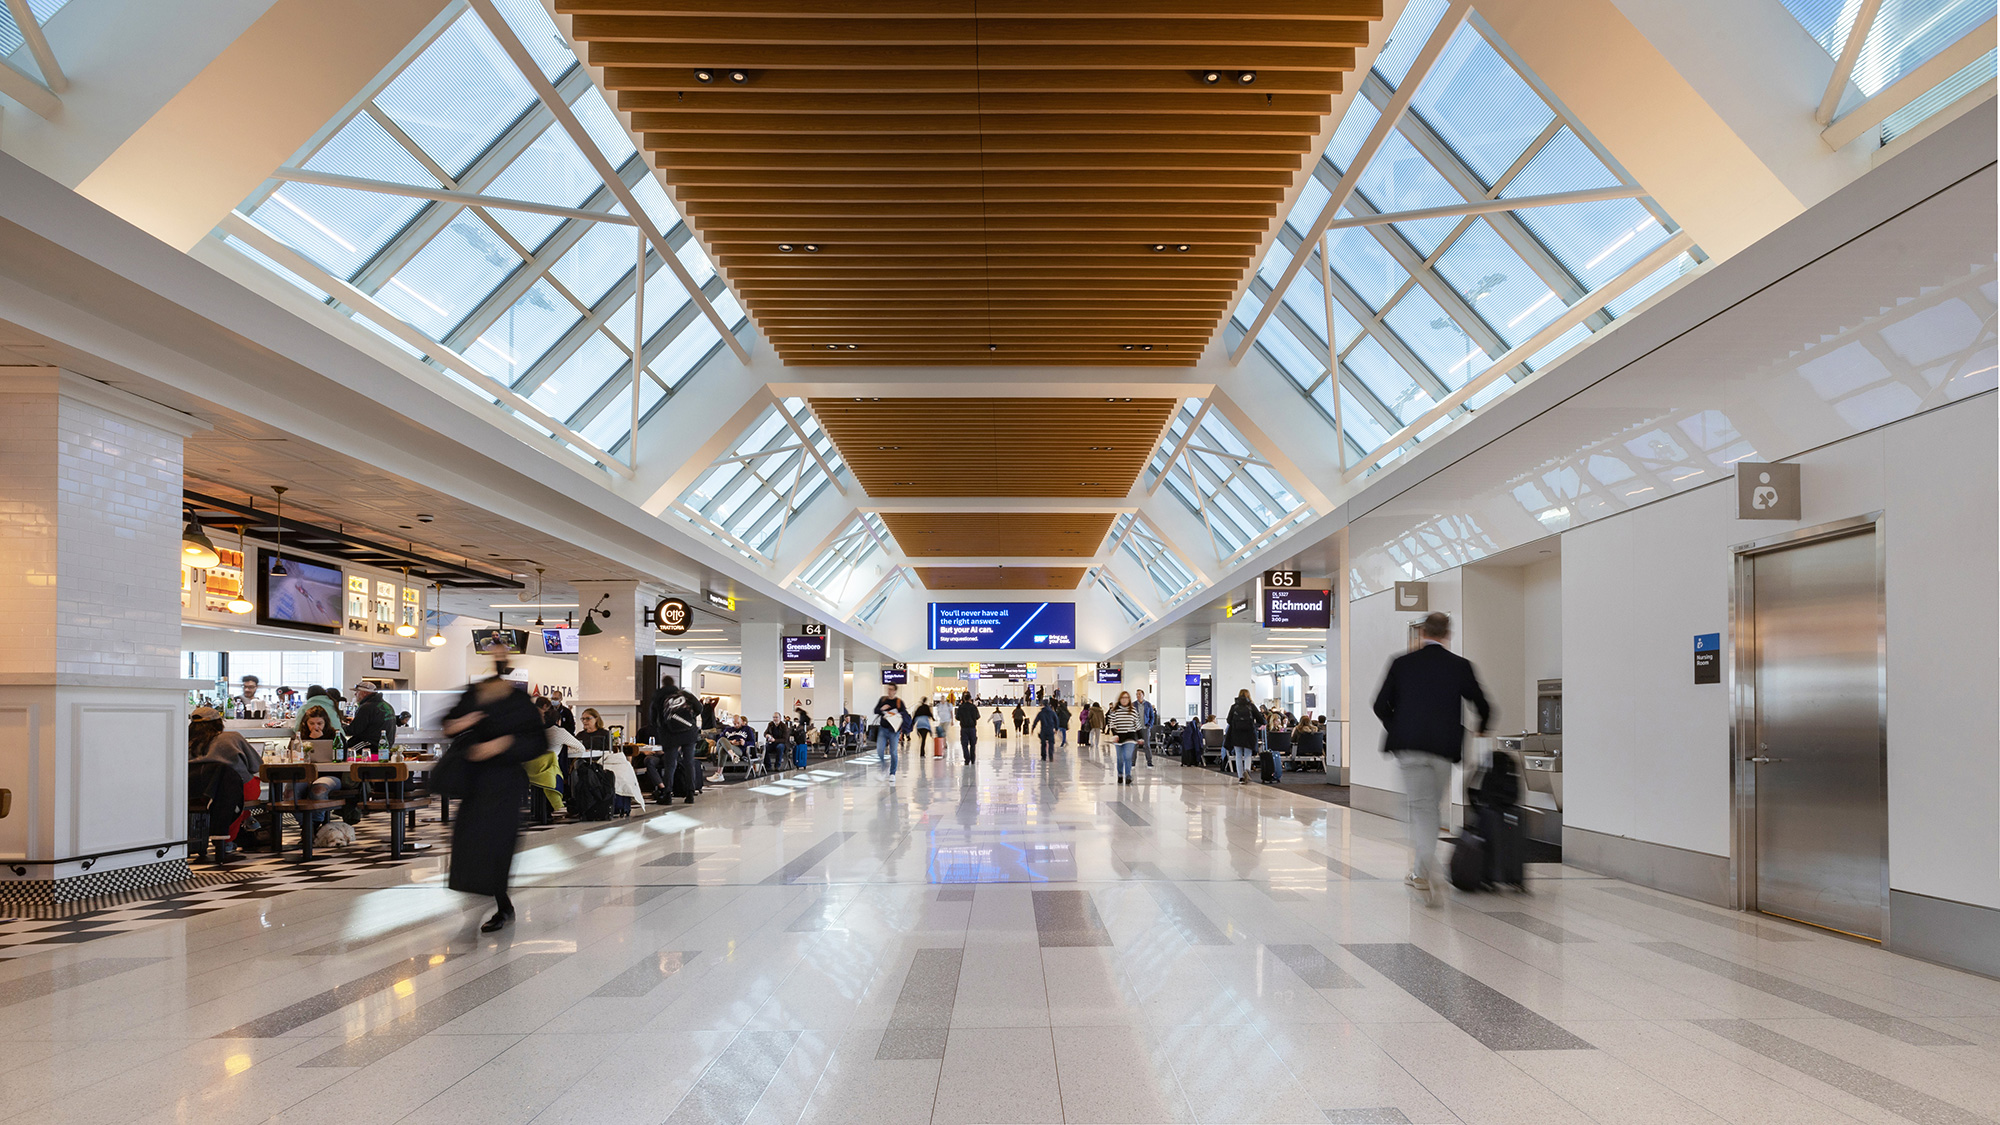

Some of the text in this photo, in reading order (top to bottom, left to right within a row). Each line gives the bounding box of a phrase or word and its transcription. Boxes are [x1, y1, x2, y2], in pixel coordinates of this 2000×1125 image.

[1272, 572, 1293, 586] 65
[1271, 599, 1323, 611] Richmond
[660, 602, 685, 625] Cotto
[953, 618, 969, 626] right
[806, 624, 822, 635] 64
